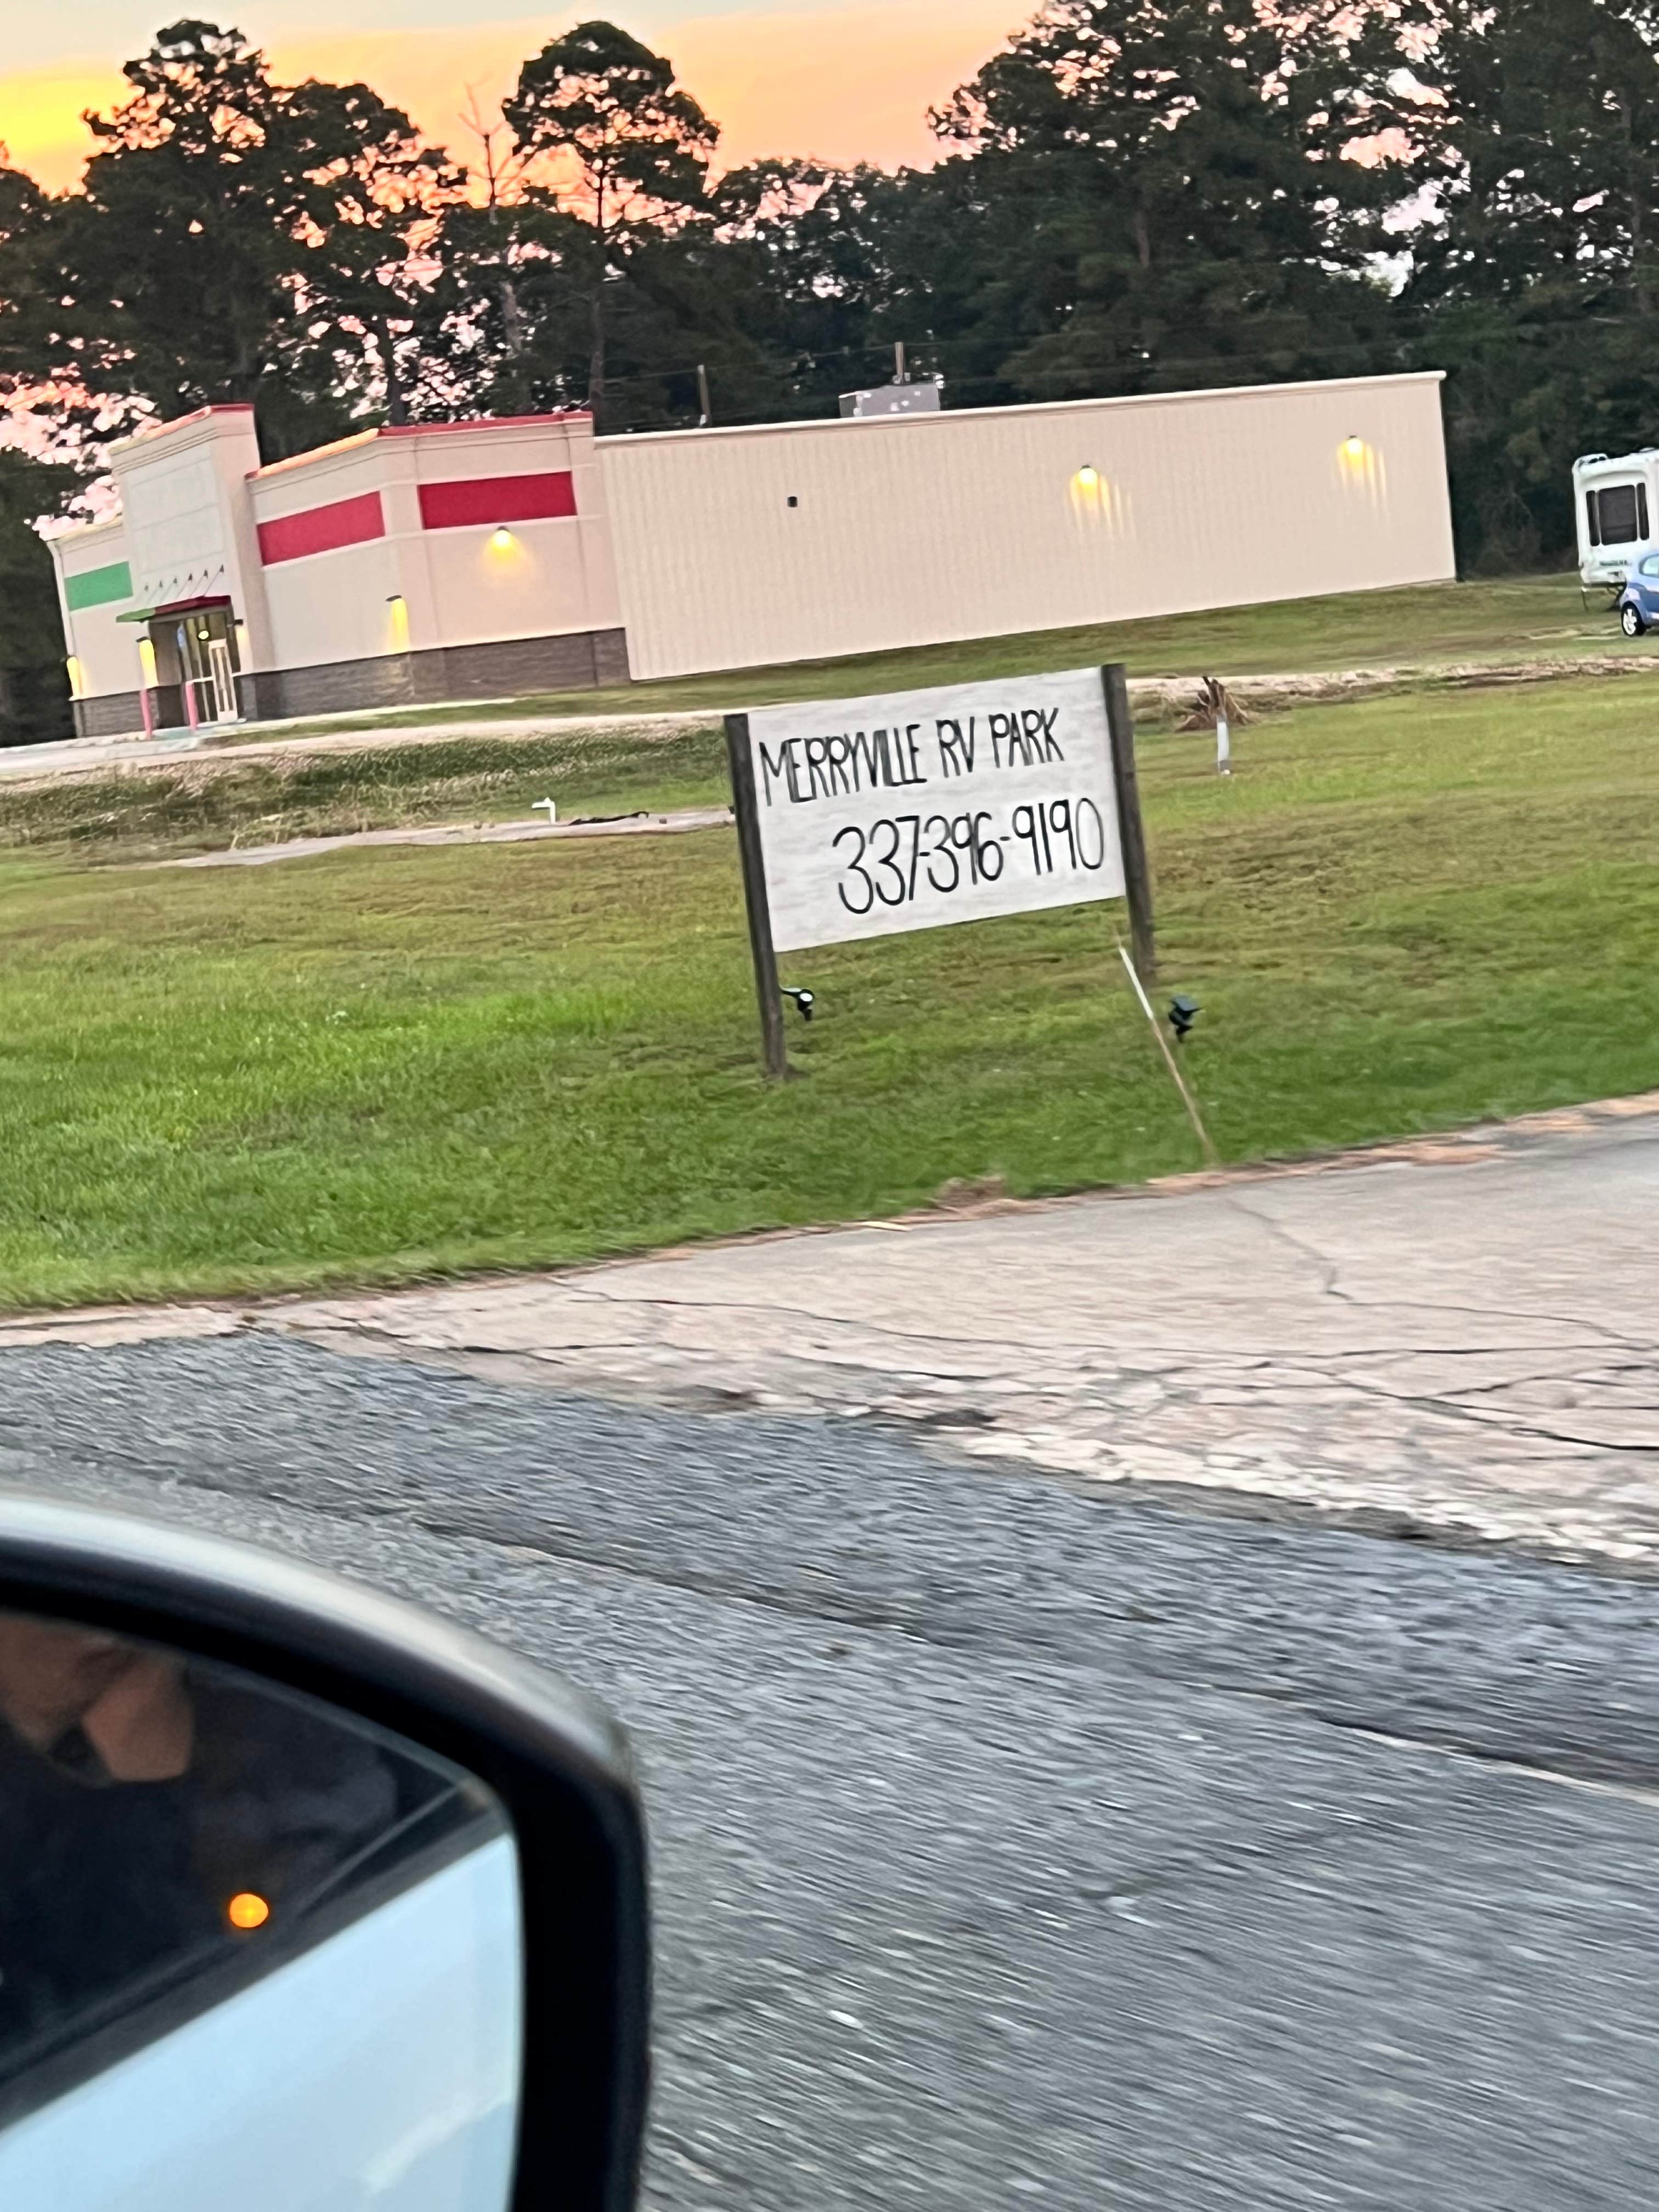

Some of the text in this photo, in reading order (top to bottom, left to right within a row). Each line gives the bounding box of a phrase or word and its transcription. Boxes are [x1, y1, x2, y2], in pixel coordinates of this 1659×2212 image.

[759, 708, 1065, 806] MERRYVILLE RV PARK
[832, 798, 1104, 915] 337-396-9190
